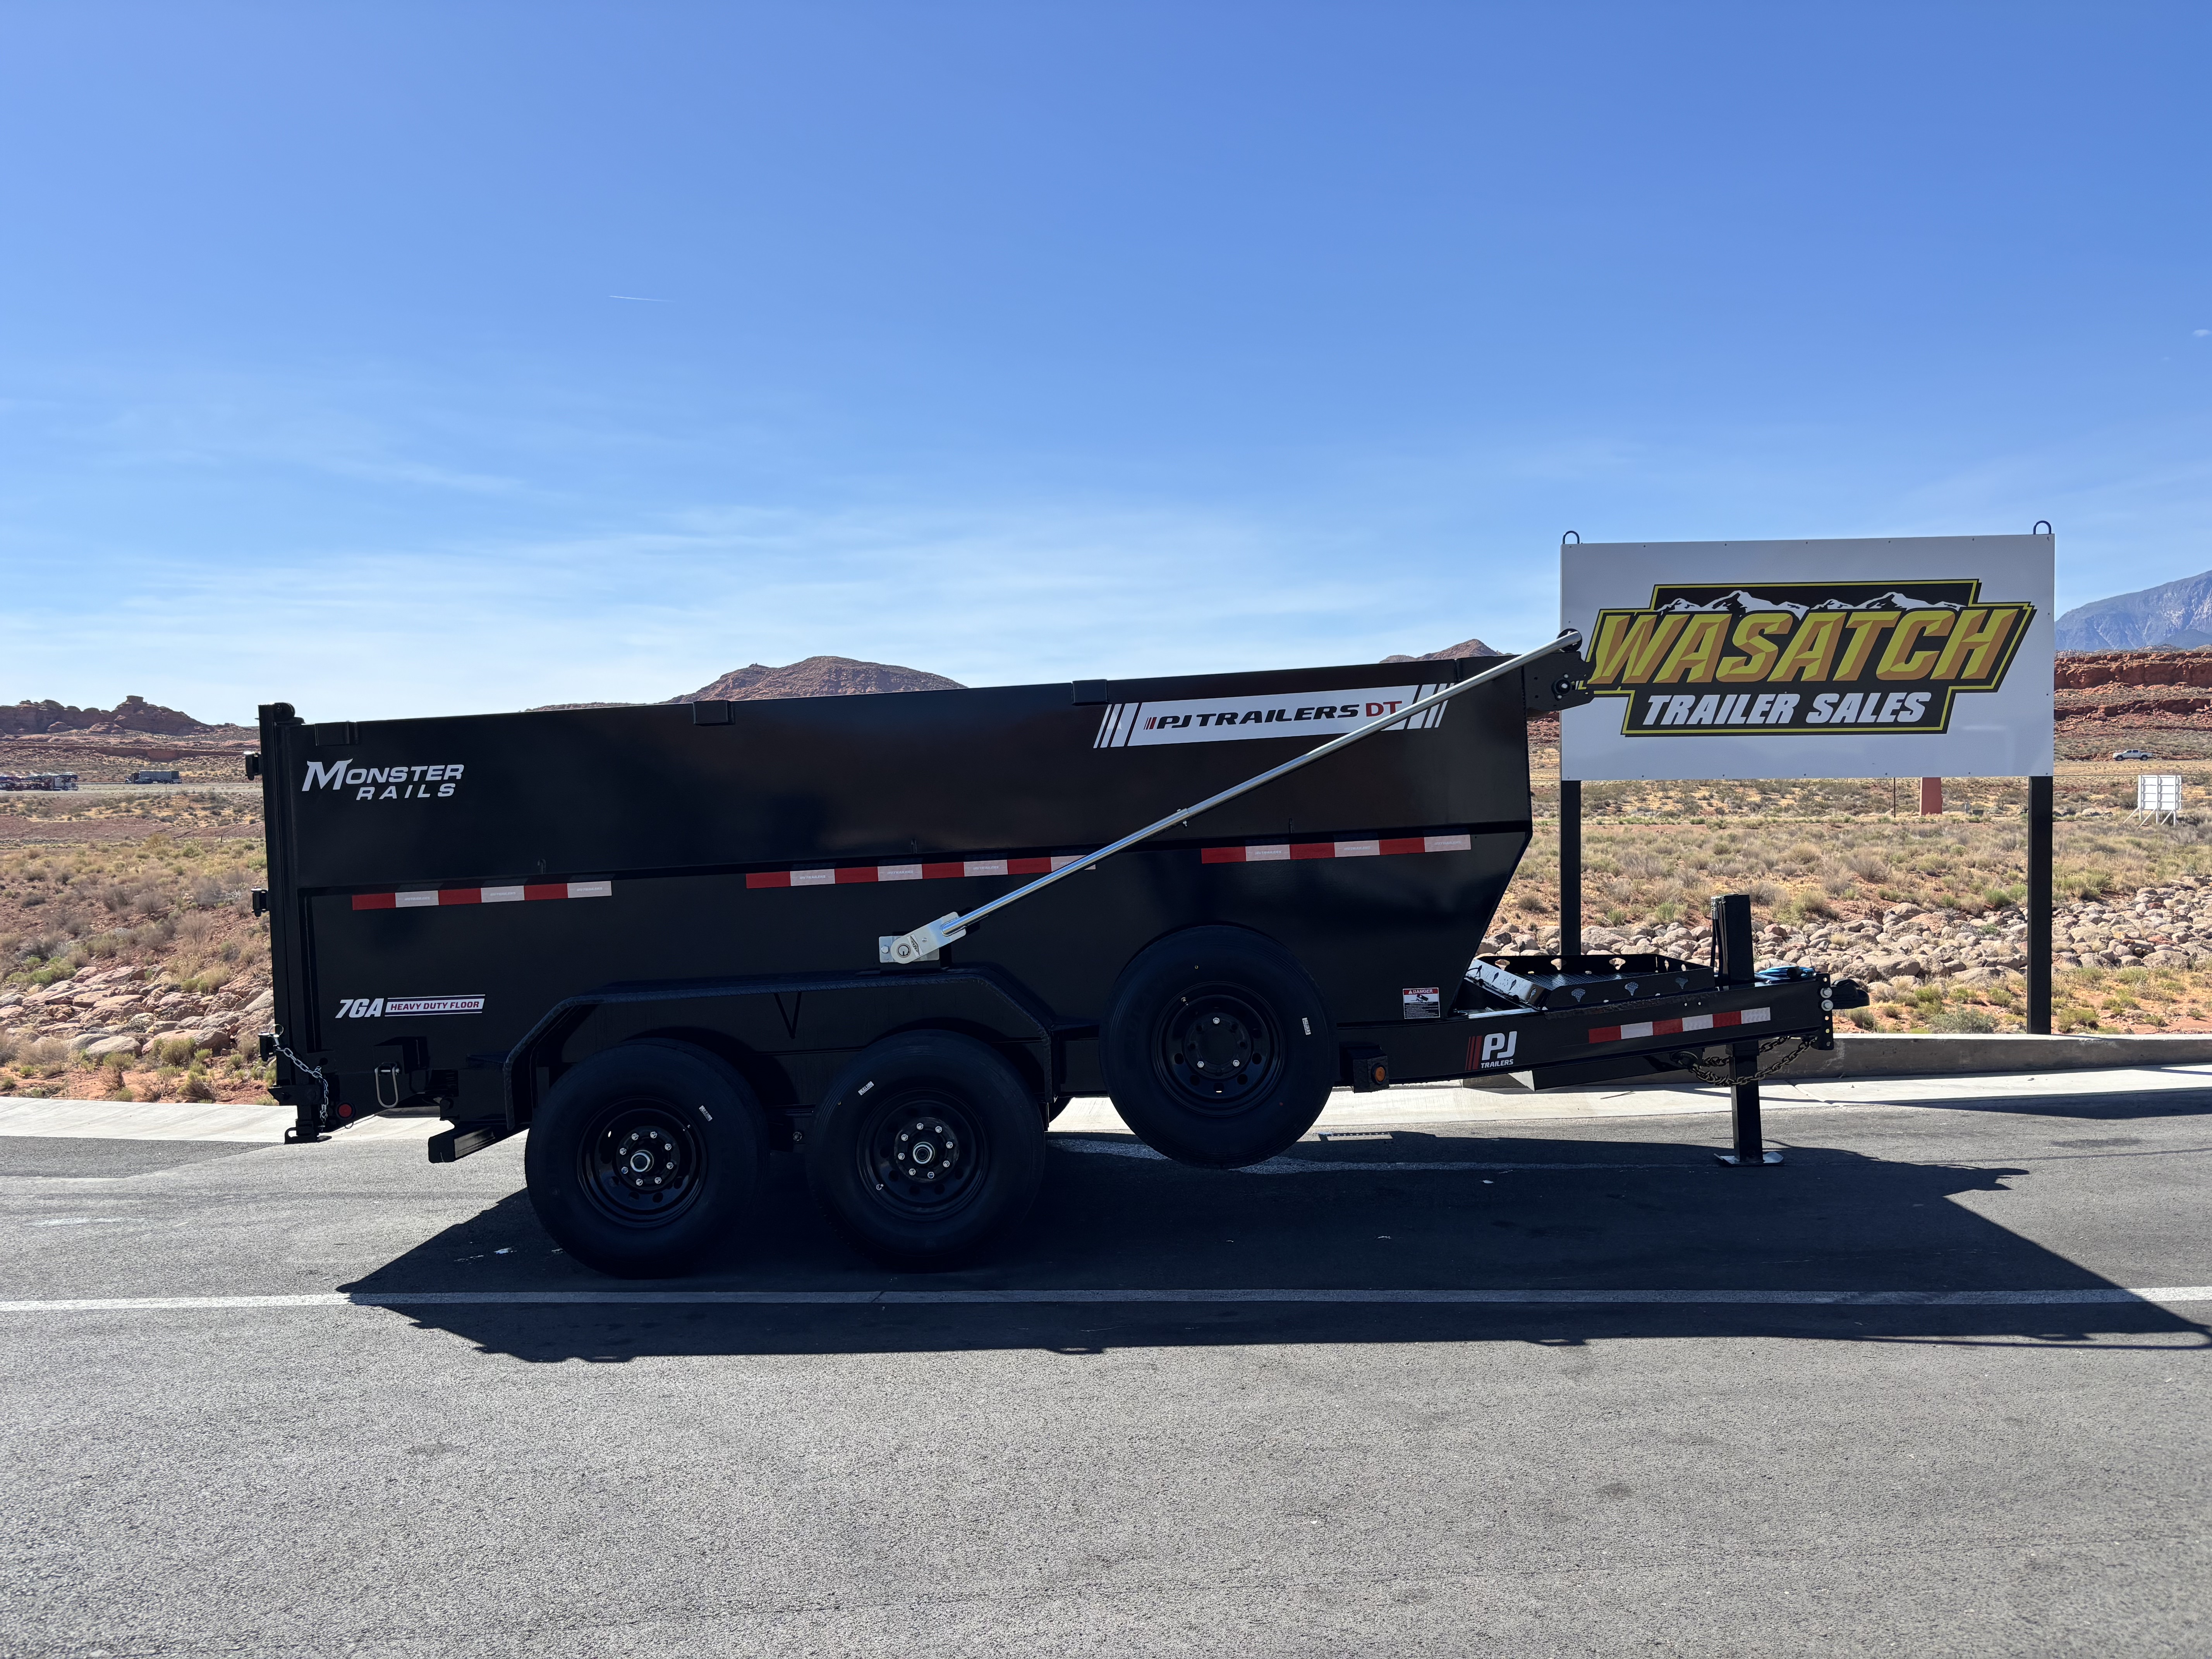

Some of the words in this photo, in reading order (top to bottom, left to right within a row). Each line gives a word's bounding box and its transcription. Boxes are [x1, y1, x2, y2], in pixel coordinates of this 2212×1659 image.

[1587, 608, 2018, 684] WASATCH
[1156, 714, 1192, 729] PJ
[1196, 704, 1360, 726] TRAILERS
[1365, 701, 1402, 717] DT
[1642, 693, 1800, 726] TRAILER
[1805, 692, 1932, 723] SALES
[302, 758, 464, 792] MONSTER
[356, 783, 456, 800] RAILS
[335, 998, 384, 1018] 7GA
[1482, 1031, 1517, 1061] PJ
[1480, 1059, 1514, 1068] TRAILERS
